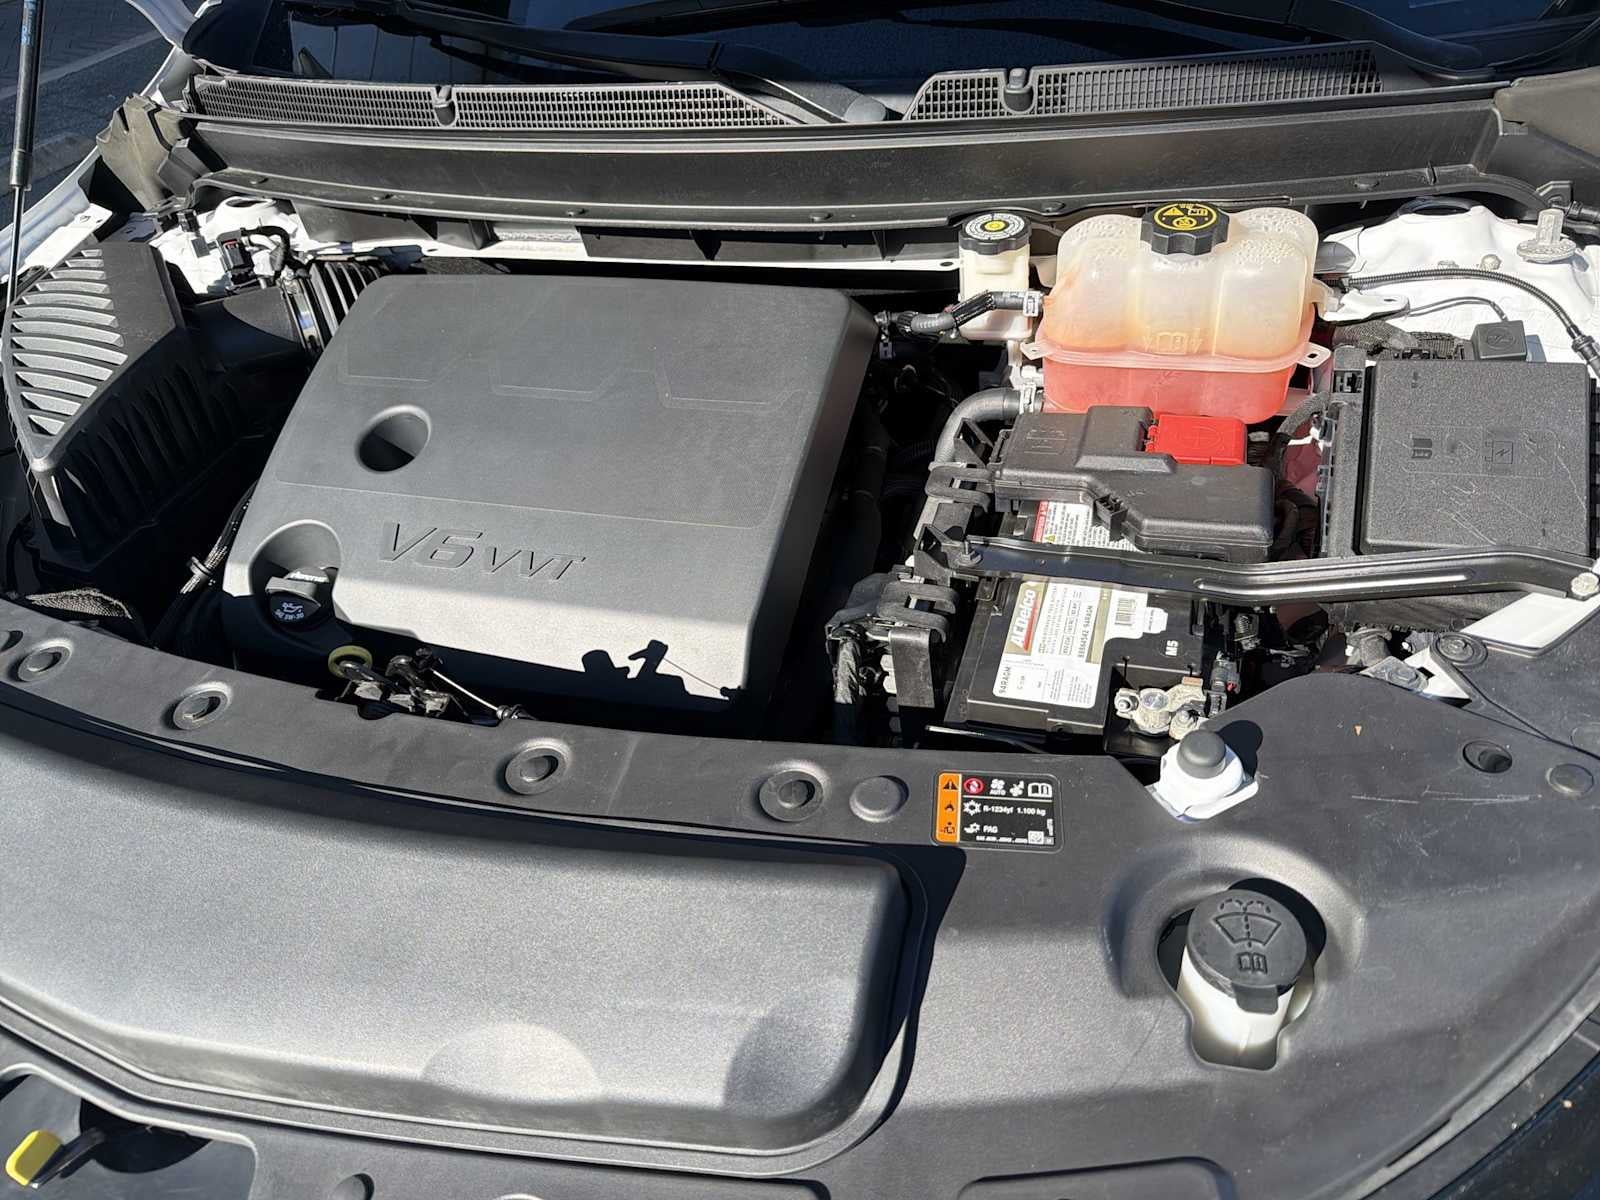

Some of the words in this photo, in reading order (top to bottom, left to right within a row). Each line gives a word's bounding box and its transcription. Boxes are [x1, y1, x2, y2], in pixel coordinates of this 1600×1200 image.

[379, 521, 485, 569] V6
[480, 546, 587, 582] VVT
[1010, 589, 1037, 649] ACDelco
[983, 805, 1014, 815] R-1234yf
[1017, 807, 1036, 815] 1.100
[1036, 808, 1047, 817] kg
[983, 825, 998, 834] PAG
